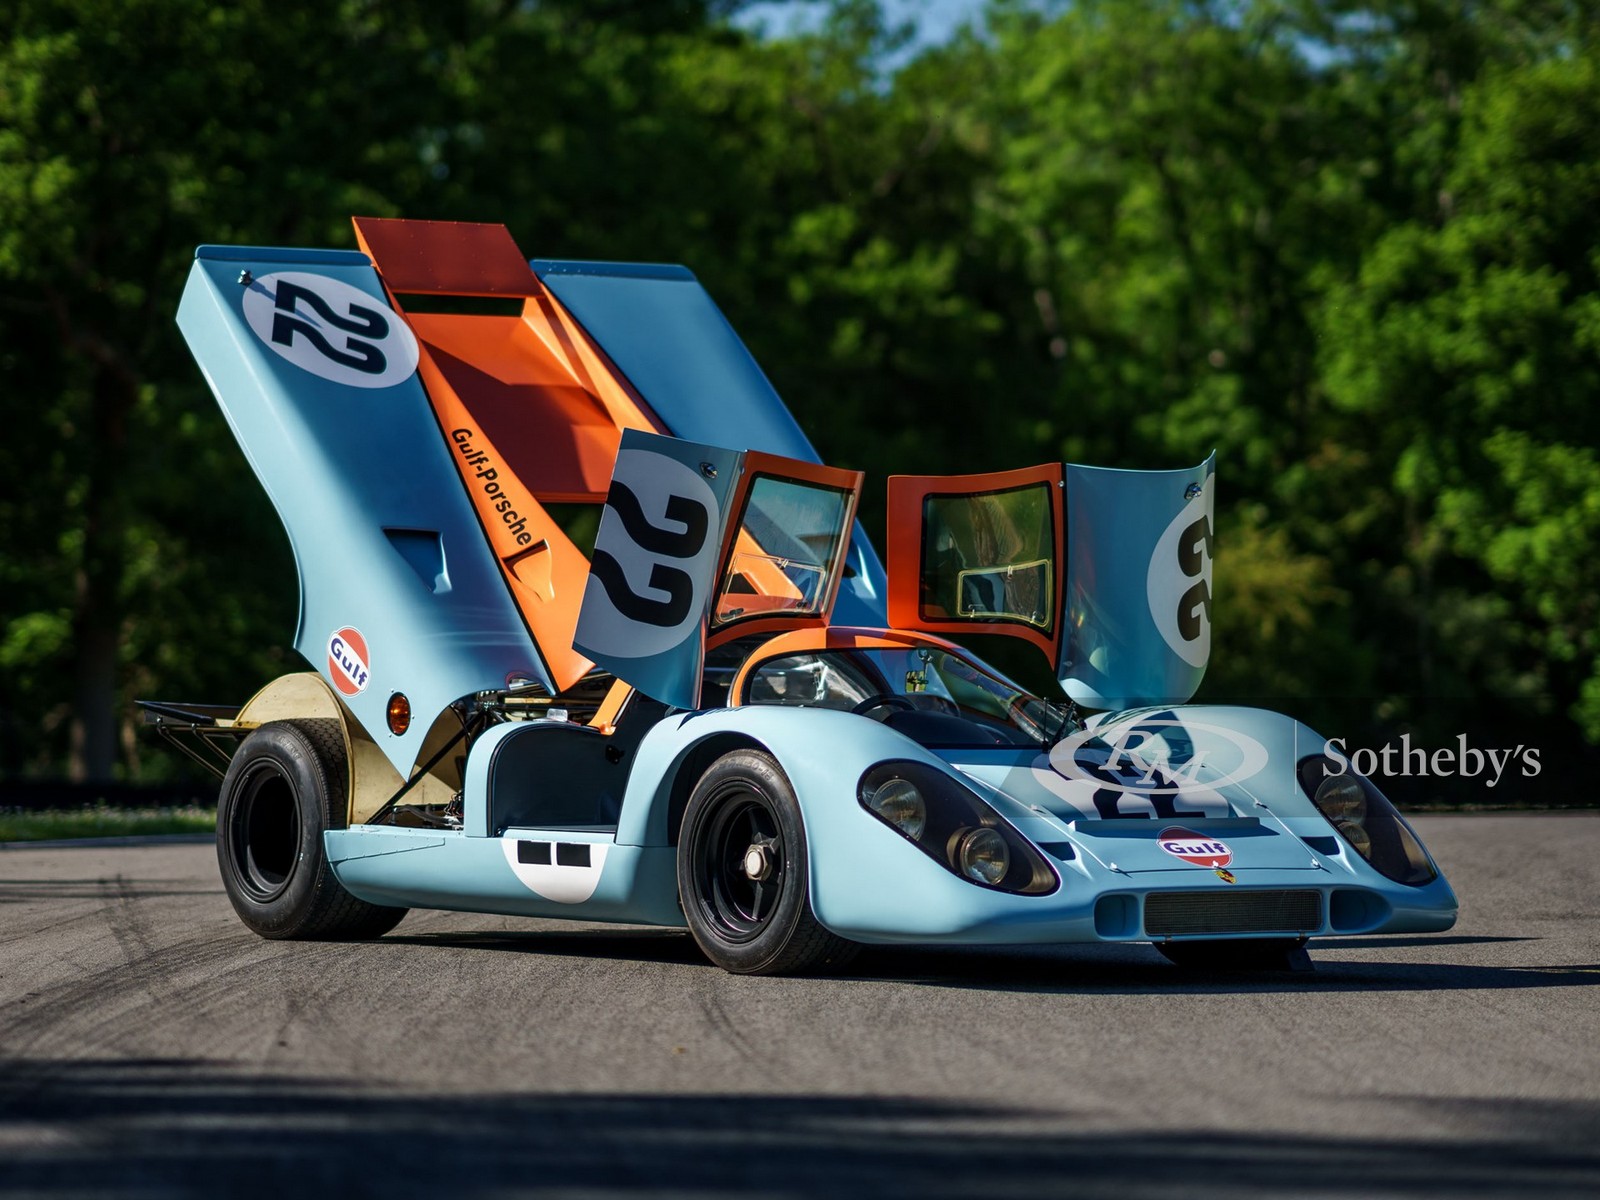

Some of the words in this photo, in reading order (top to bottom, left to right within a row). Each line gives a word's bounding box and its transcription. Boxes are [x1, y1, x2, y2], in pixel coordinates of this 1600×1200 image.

[272, 279, 389, 375] 22
[451, 428, 532, 547] Gulf-Porsche
[331, 637, 368, 687] Gulf
[1163, 841, 1227, 854] Gulf
